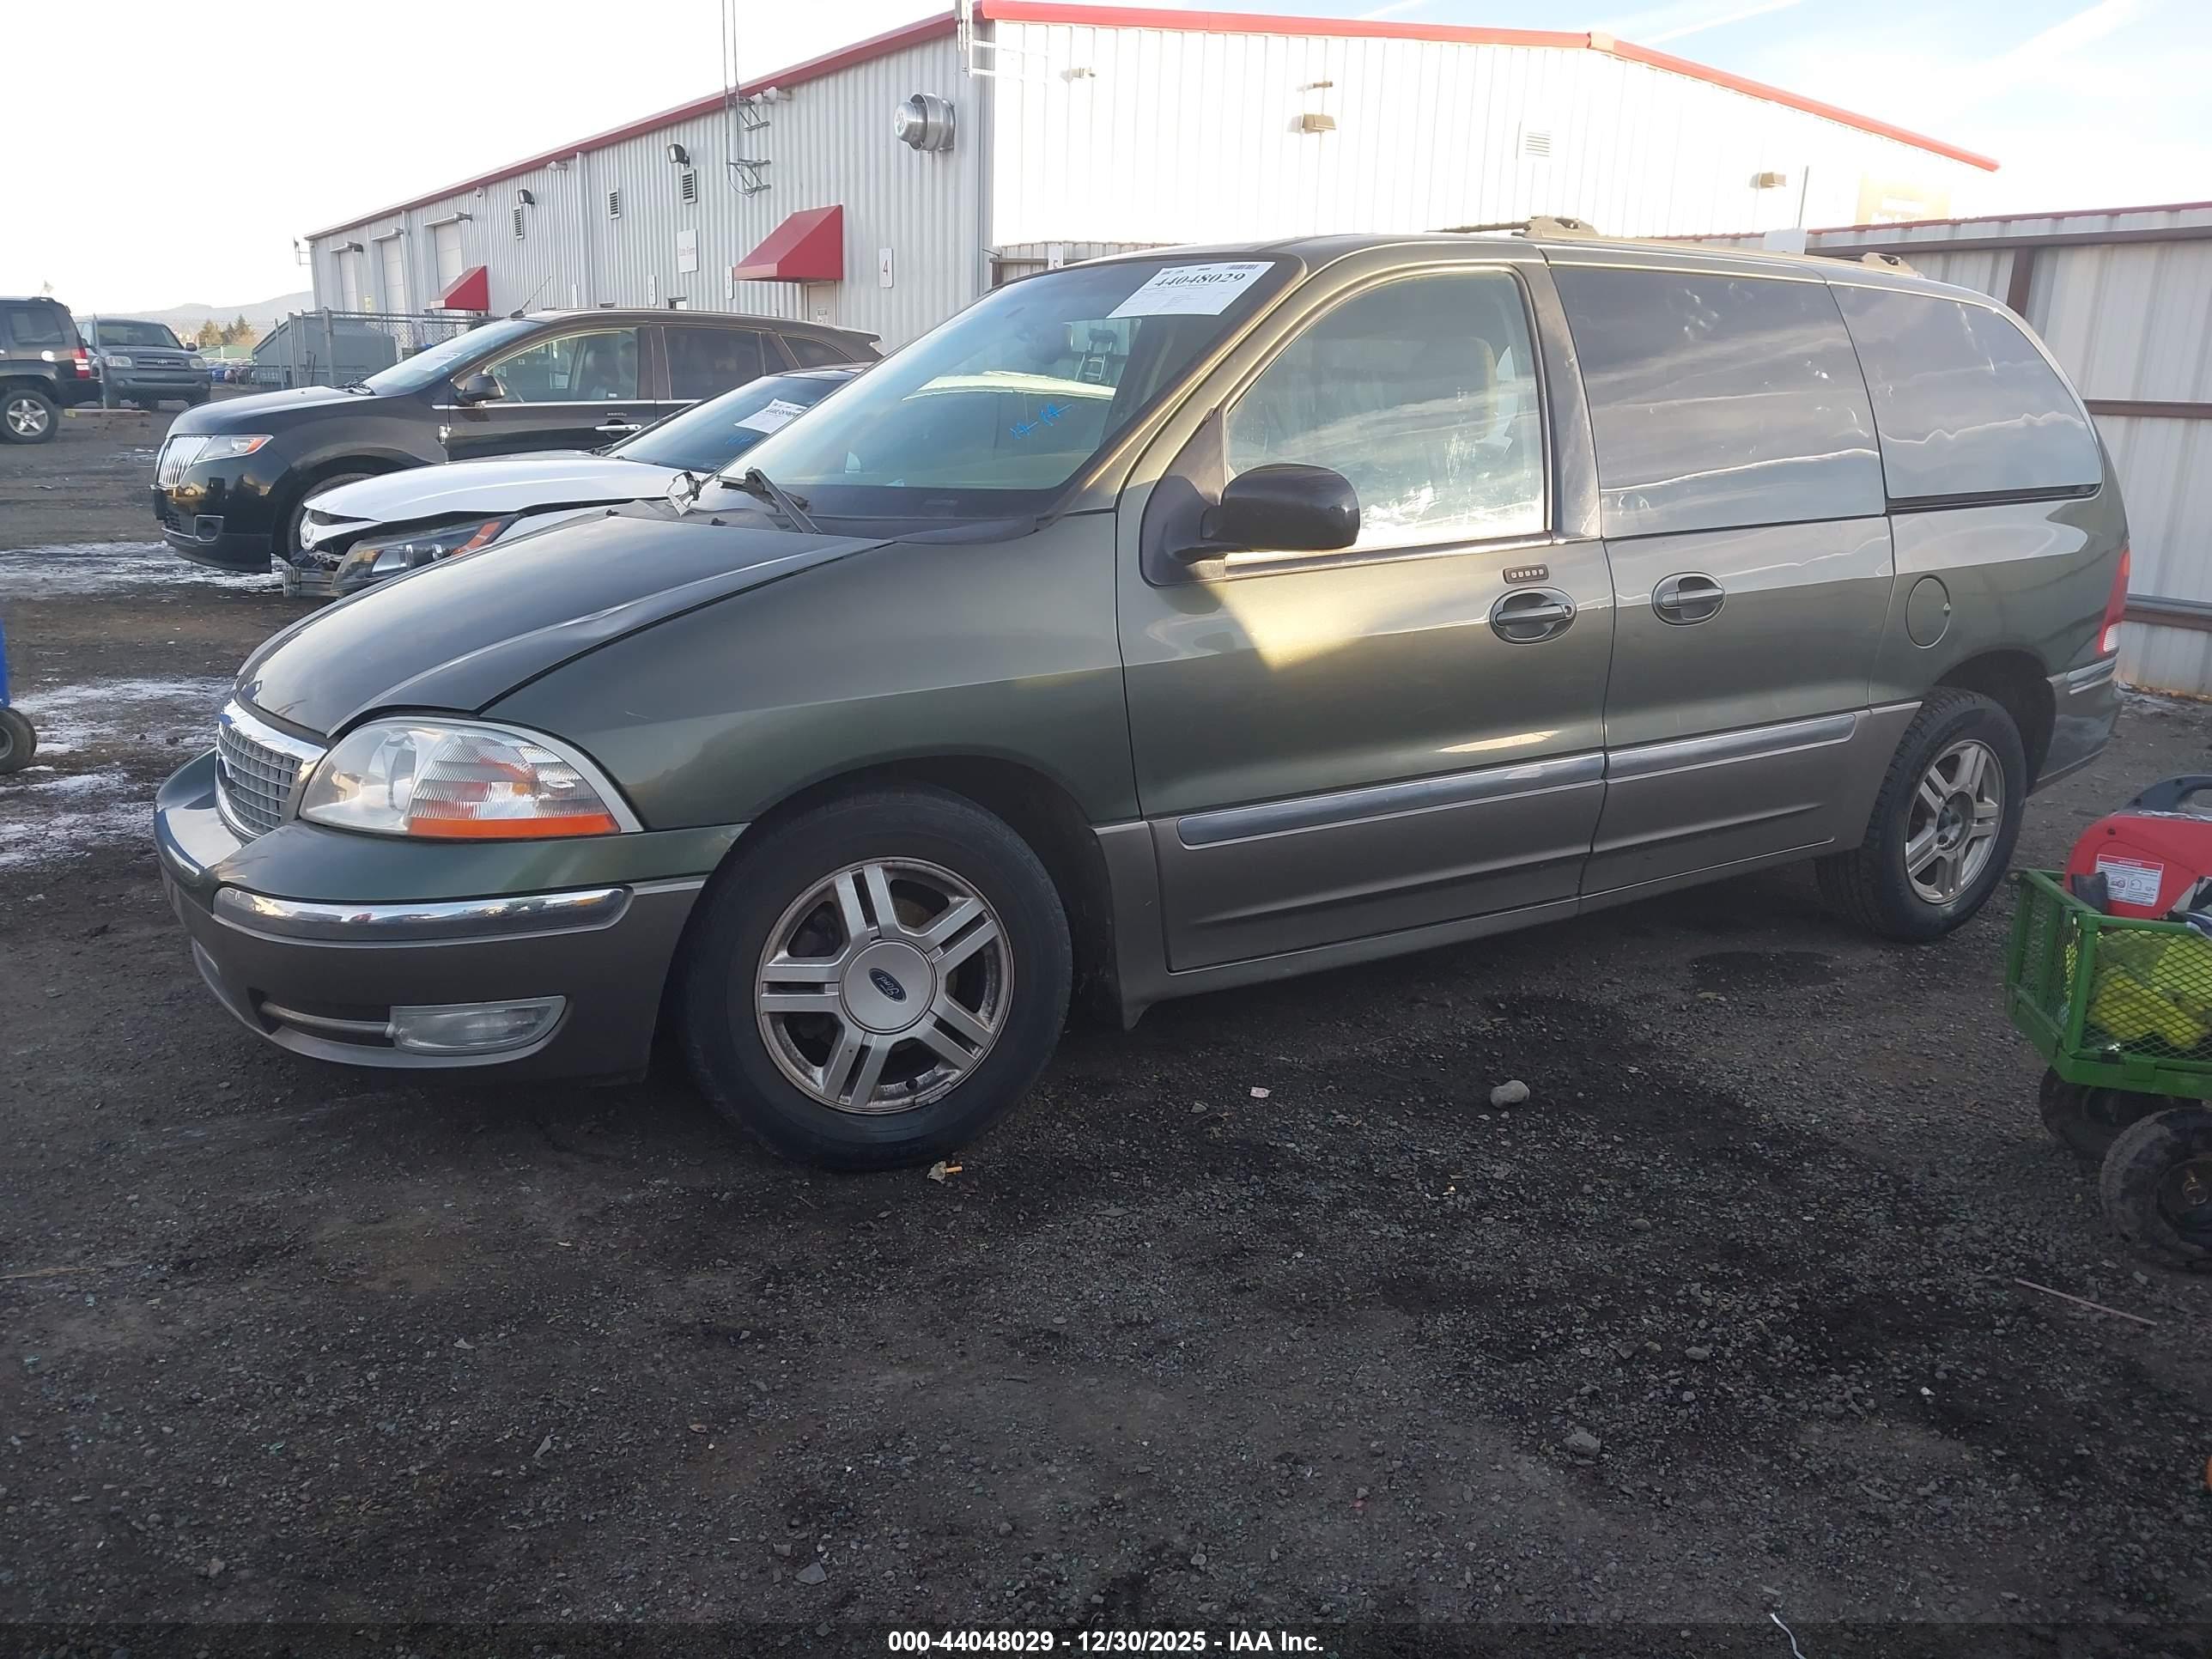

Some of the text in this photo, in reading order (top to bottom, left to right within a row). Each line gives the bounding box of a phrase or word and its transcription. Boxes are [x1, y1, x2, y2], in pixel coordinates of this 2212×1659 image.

[883, 259, 889, 276] 4
[1154, 272, 1246, 287] 44048029
[874, 973, 902, 998] Ford
